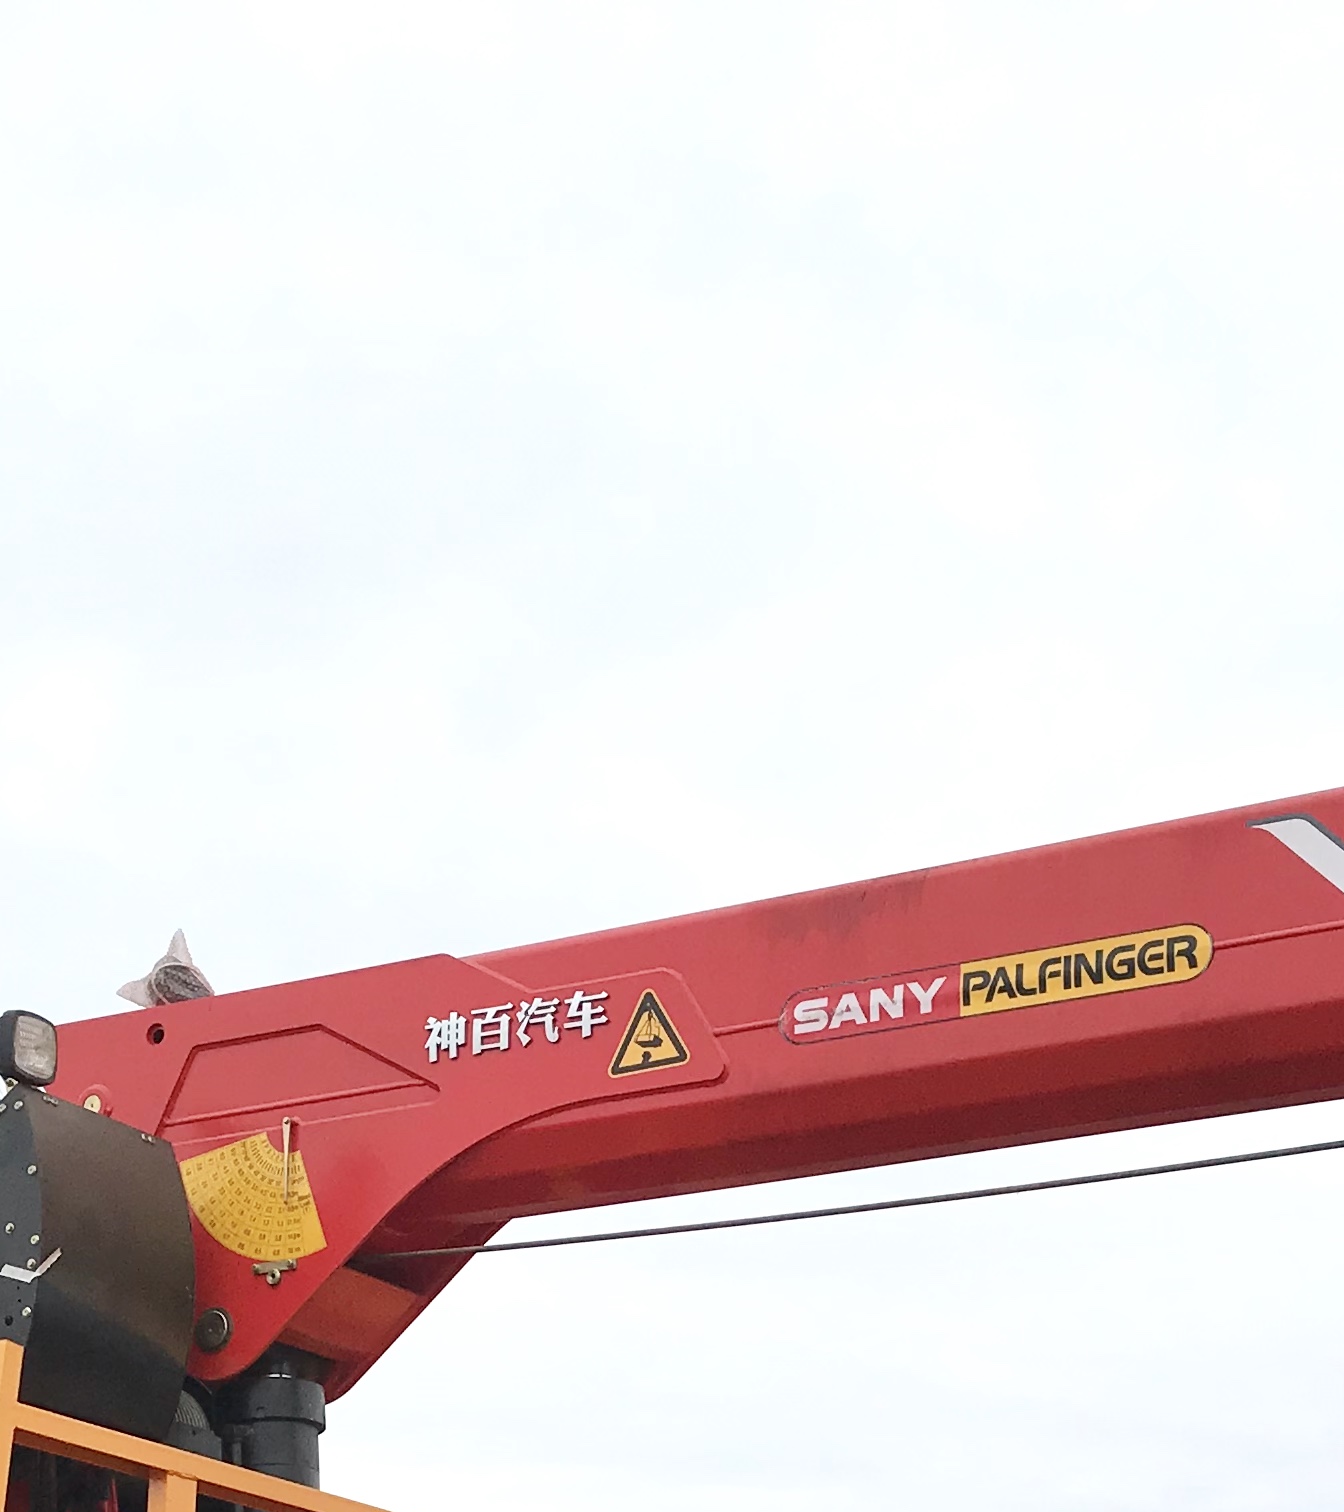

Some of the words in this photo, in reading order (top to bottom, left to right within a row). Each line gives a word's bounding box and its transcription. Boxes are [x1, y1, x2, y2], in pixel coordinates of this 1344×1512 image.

[424, 991, 609, 1063] 神百汽车
[794, 977, 948, 1035] SANY
[963, 934, 1198, 1006] PALFINGER
